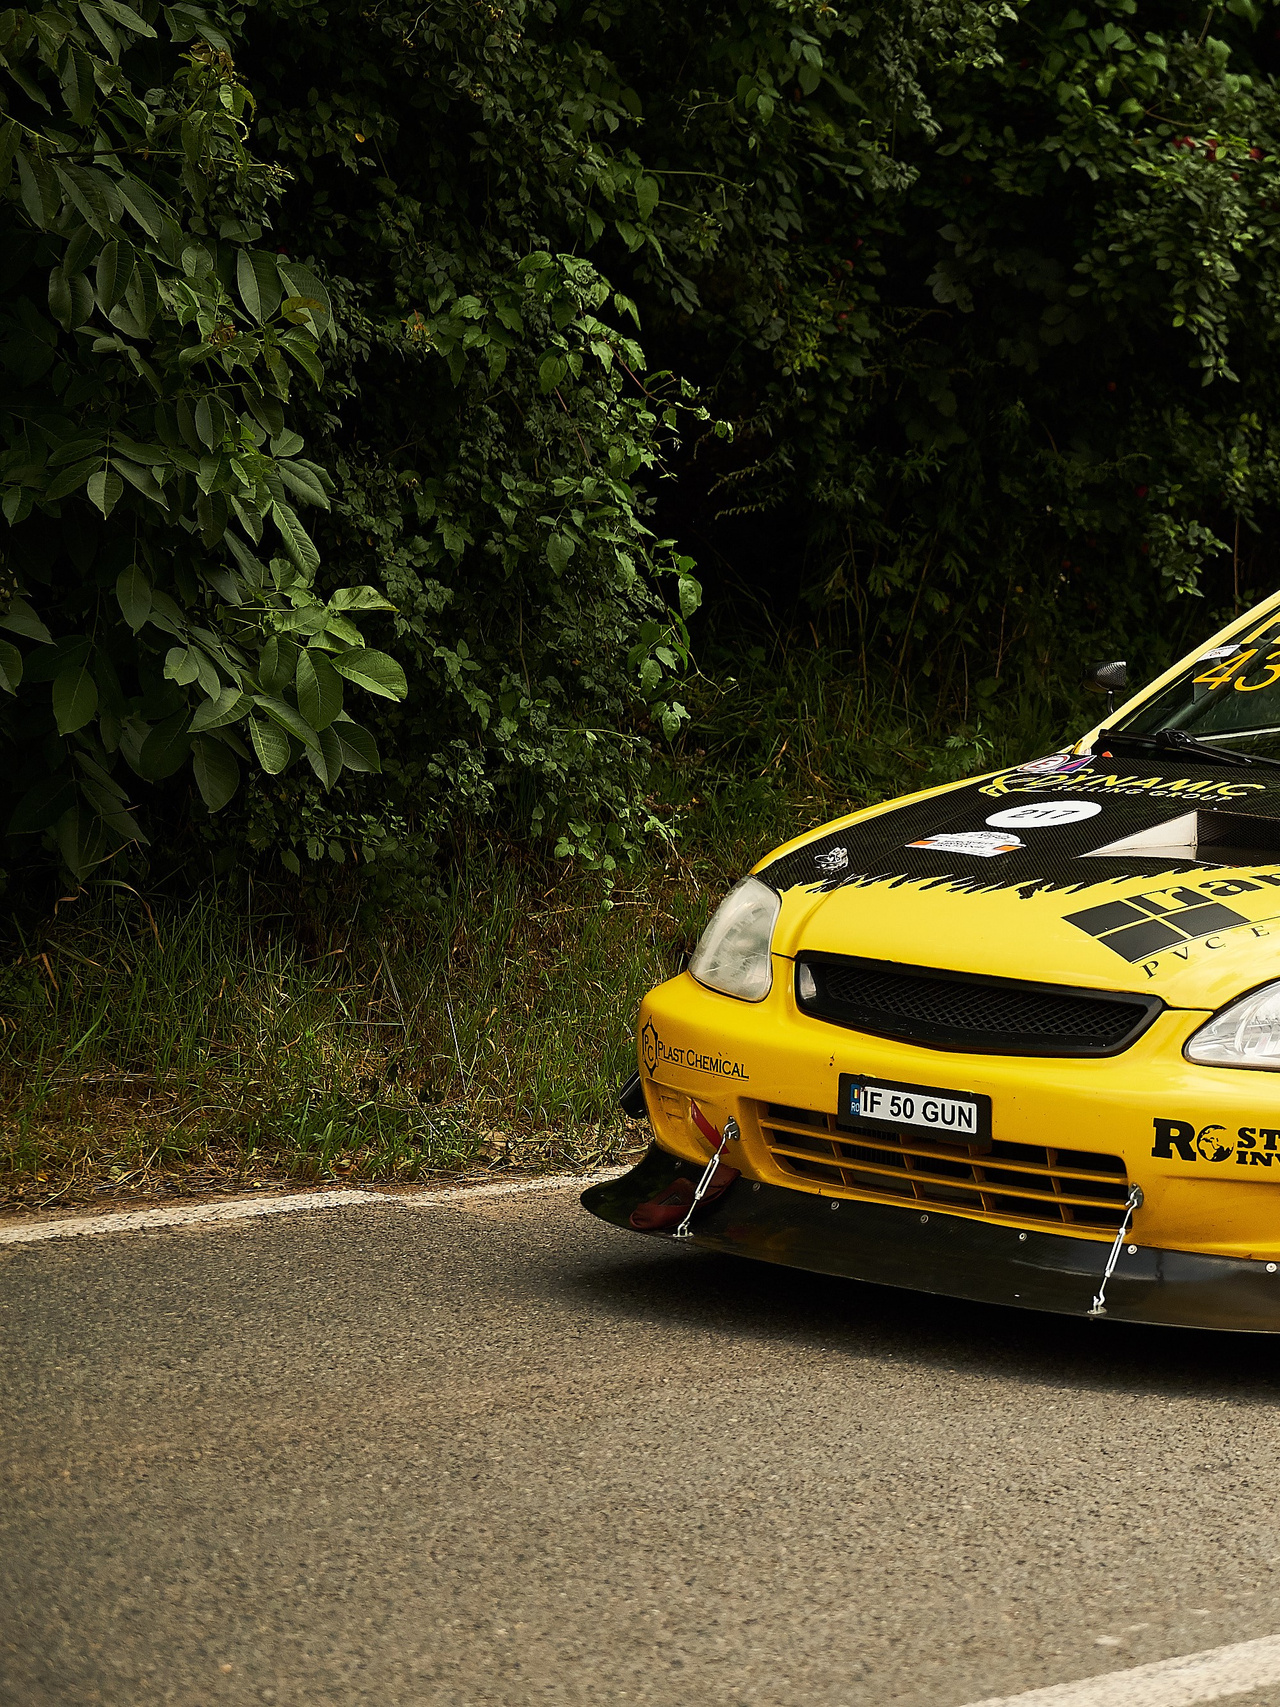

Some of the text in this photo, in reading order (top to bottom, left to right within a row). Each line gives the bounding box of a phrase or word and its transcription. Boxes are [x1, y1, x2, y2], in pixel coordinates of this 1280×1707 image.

[1024, 774, 1266, 796] DYNAMIC
[1051, 786, 1233, 802] SELLING GROUP
[1006, 810, 1080, 820] 217
[1141, 936, 1226, 980] PVC
[657, 1040, 750, 1080] PLAST CHEMICAL
[851, 1101, 860, 1112] RO
[863, 1090, 973, 1129] IF 50 GUN
